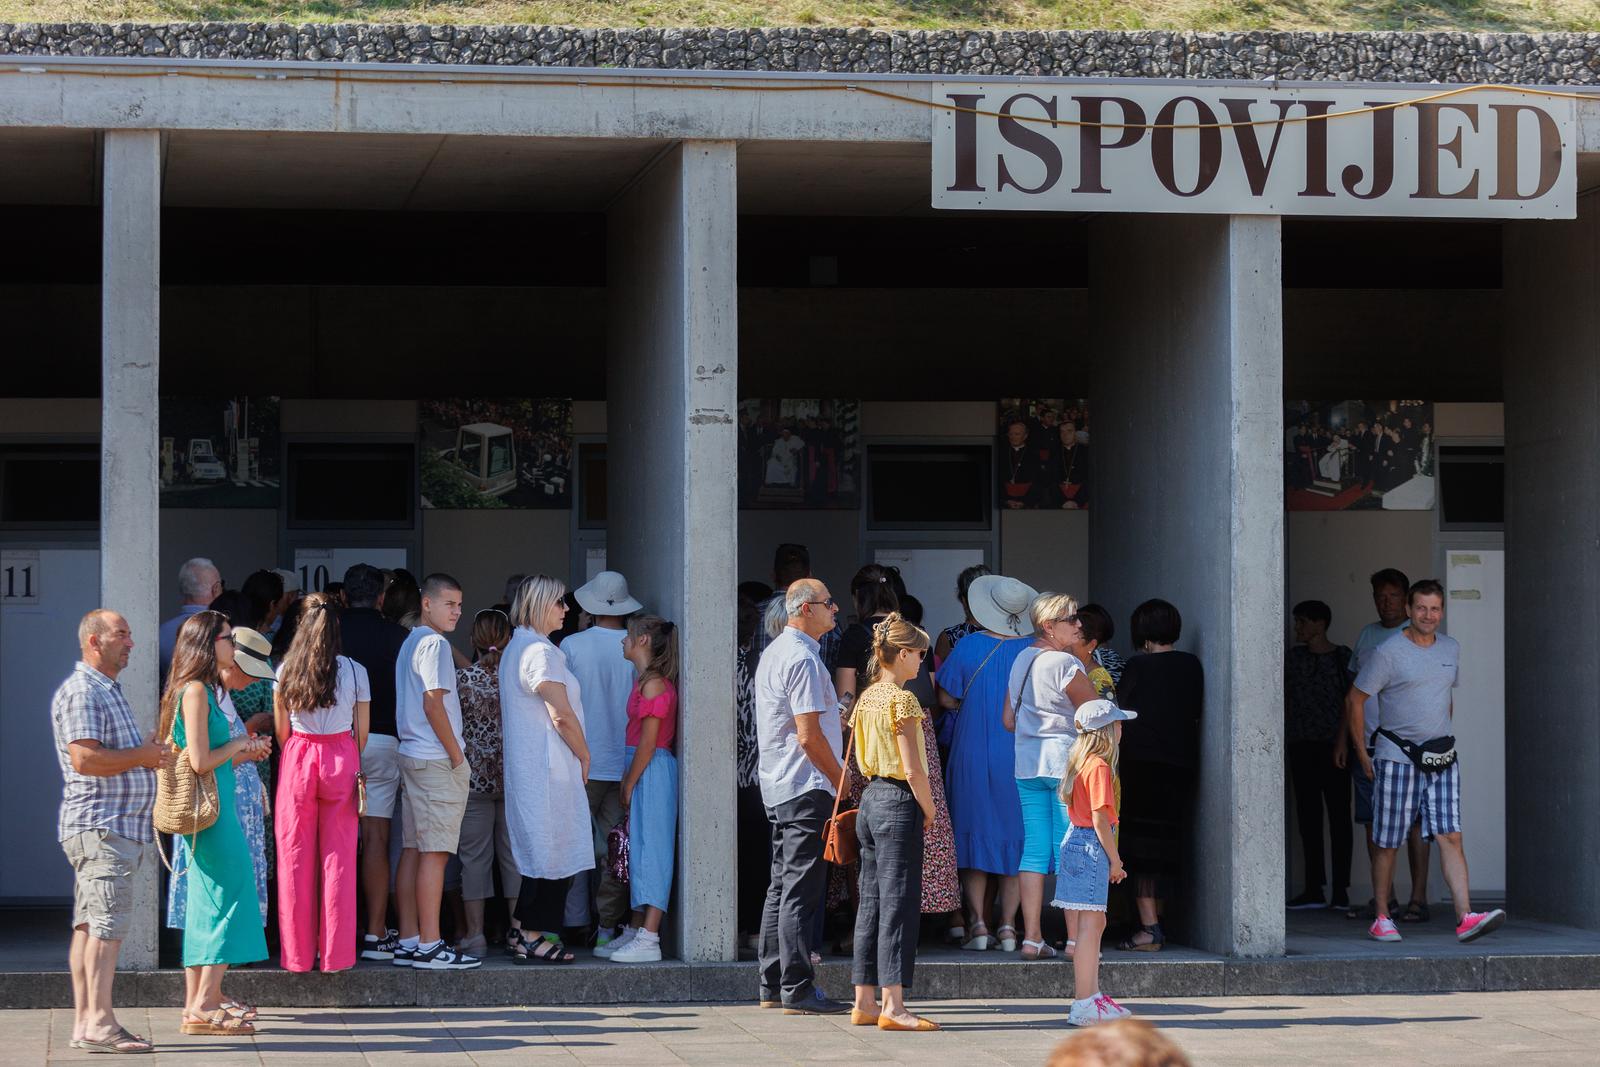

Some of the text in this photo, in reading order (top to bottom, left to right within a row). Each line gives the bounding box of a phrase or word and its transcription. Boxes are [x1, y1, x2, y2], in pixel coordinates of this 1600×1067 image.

[945, 92, 1563, 201] ISPOVIJED
[4, 565, 36, 598] 11
[298, 564, 330, 593] 10
